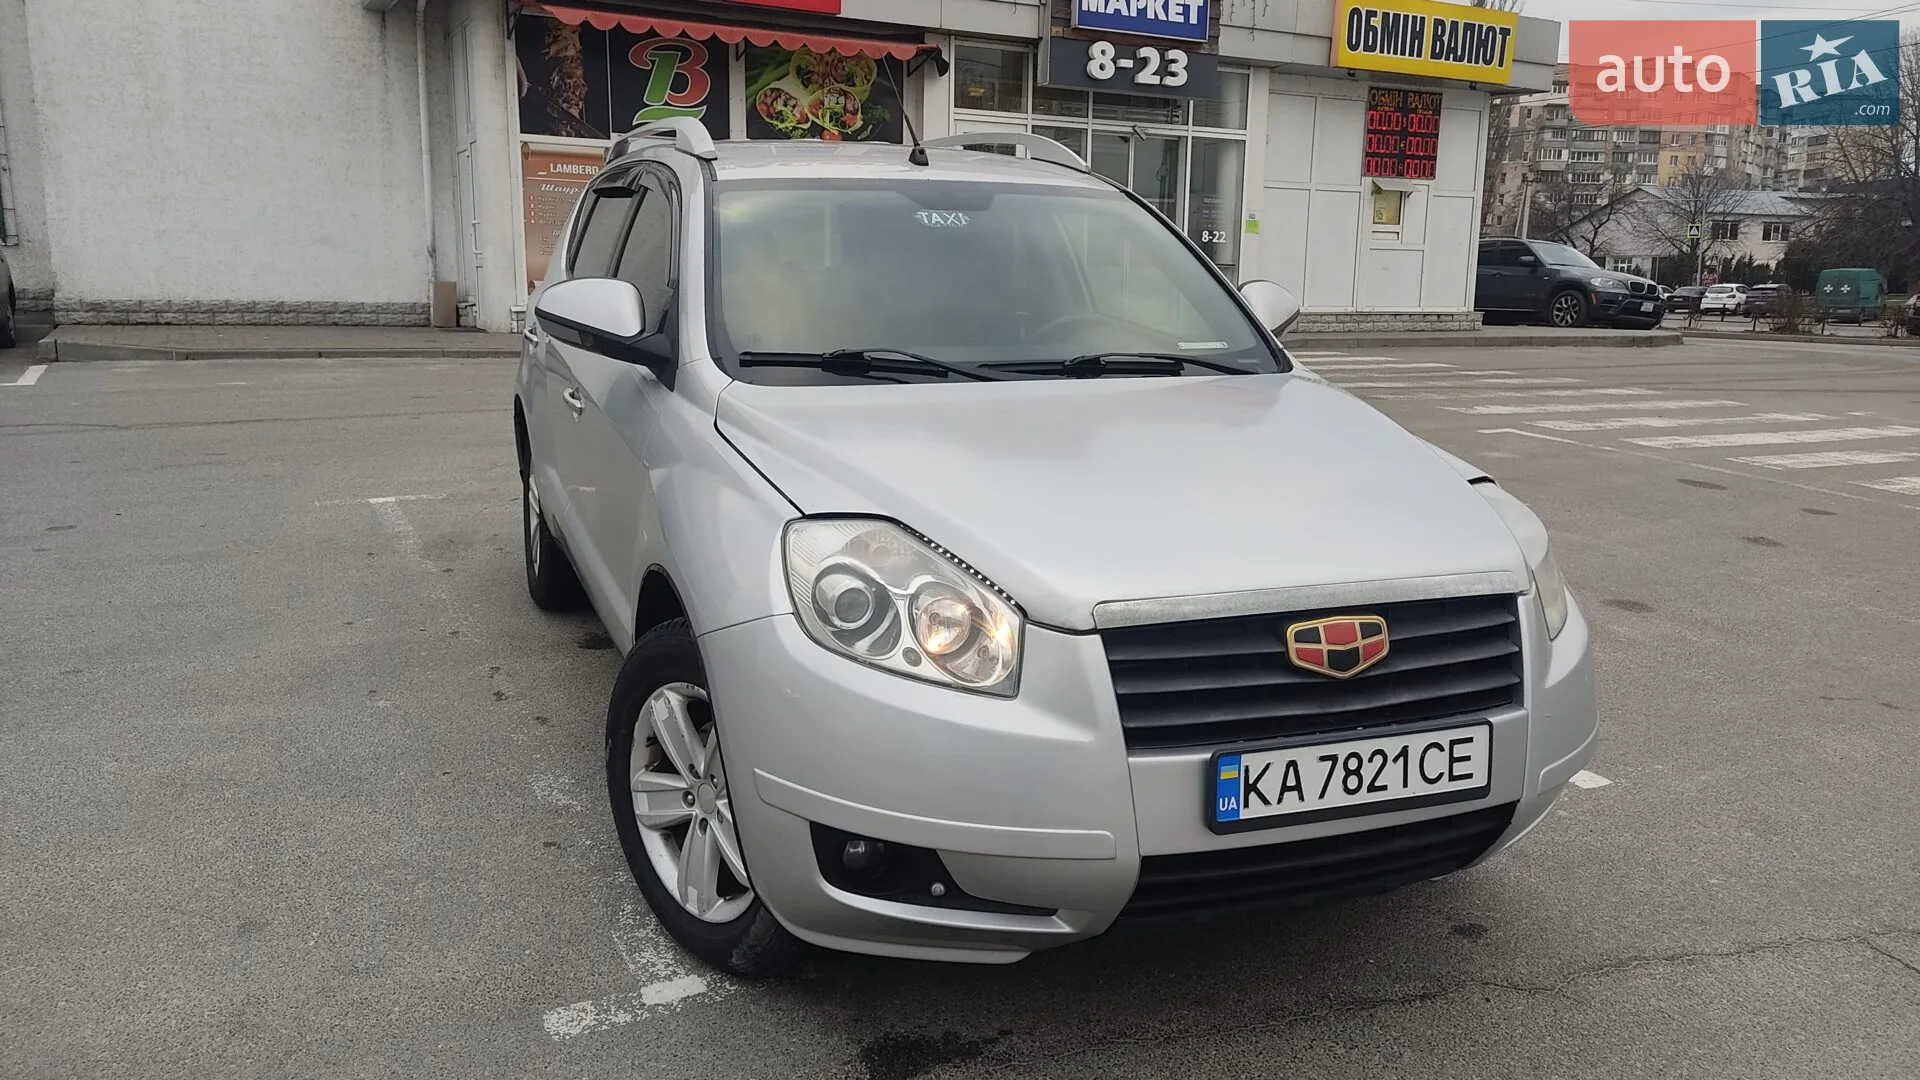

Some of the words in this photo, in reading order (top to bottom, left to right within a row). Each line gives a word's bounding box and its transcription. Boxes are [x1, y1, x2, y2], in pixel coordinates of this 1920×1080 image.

[1346, 6, 1426, 58] ОБМІН
[1429, 17, 1512, 68] ВАЛЮТ
[1087, 41, 1188, 87] 8-23
[540, 184, 585, 195] Шаур
[916, 211, 968, 225] TAXI
[1201, 230, 1226, 243] 8-22
[1243, 760, 1305, 809] KA
[1318, 745, 1409, 800] 7821
[1419, 737, 1475, 785] CE
[1219, 796, 1238, 812] UA
